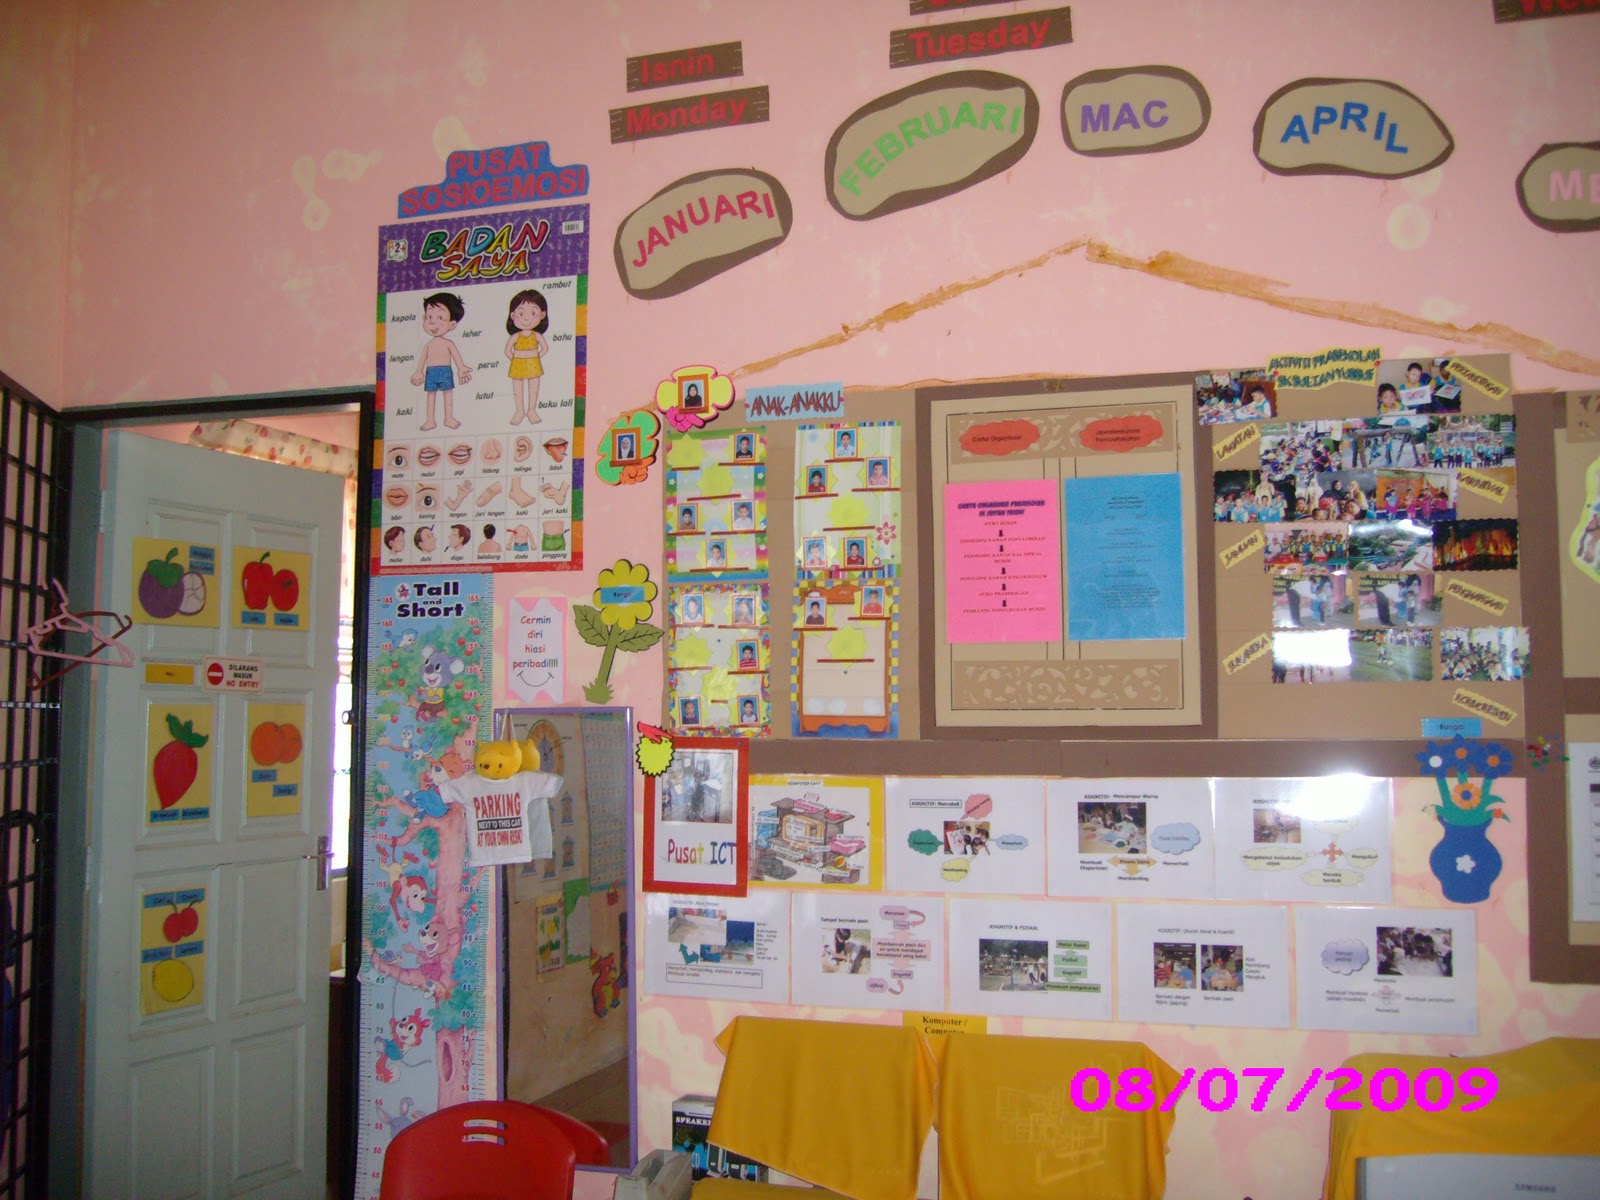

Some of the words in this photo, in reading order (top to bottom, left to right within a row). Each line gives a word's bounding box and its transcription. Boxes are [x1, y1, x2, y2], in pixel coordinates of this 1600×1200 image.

[909, 18, 1049, 59] Tuesday
[642, 51, 714, 83] Isnin
[627, 96, 747, 134] Monday
[1081, 101, 1168, 133] MAC
[1280, 102, 1408, 153] APRIL
[838, 102, 1022, 196] FEBRUARI
[450, 144, 545, 178] PUSAT
[402, 167, 586, 214] SOSIOEMOSI
[632, 190, 775, 268] JANUARI
[421, 221, 549, 261] BADAN
[437, 250, 529, 280] SAYA
[543, 281, 571, 290] rambut
[392, 314, 416, 322] kepala
[463, 330, 481, 338] leher
[390, 354, 414, 363] lengan
[477, 361, 499, 370] perut
[476, 392, 494, 400] lutut
[560, 399, 573, 407] lali
[751, 391, 840, 416] ANAK-ANAKKU
[396, 408, 412, 416] kaki
[414, 582, 459, 596] Tall
[397, 603, 464, 617] Short
[520, 616, 551, 624] Cermin
[528, 630, 543, 638] diri
[525, 644, 546, 653] hiasi
[229, 664, 258, 672] DILARANG
[473, 792, 520, 818] PARKING
[668, 839, 704, 864] Pusat
[710, 842, 736, 865] ICT
[923, 1016, 962, 1026] Komputer
